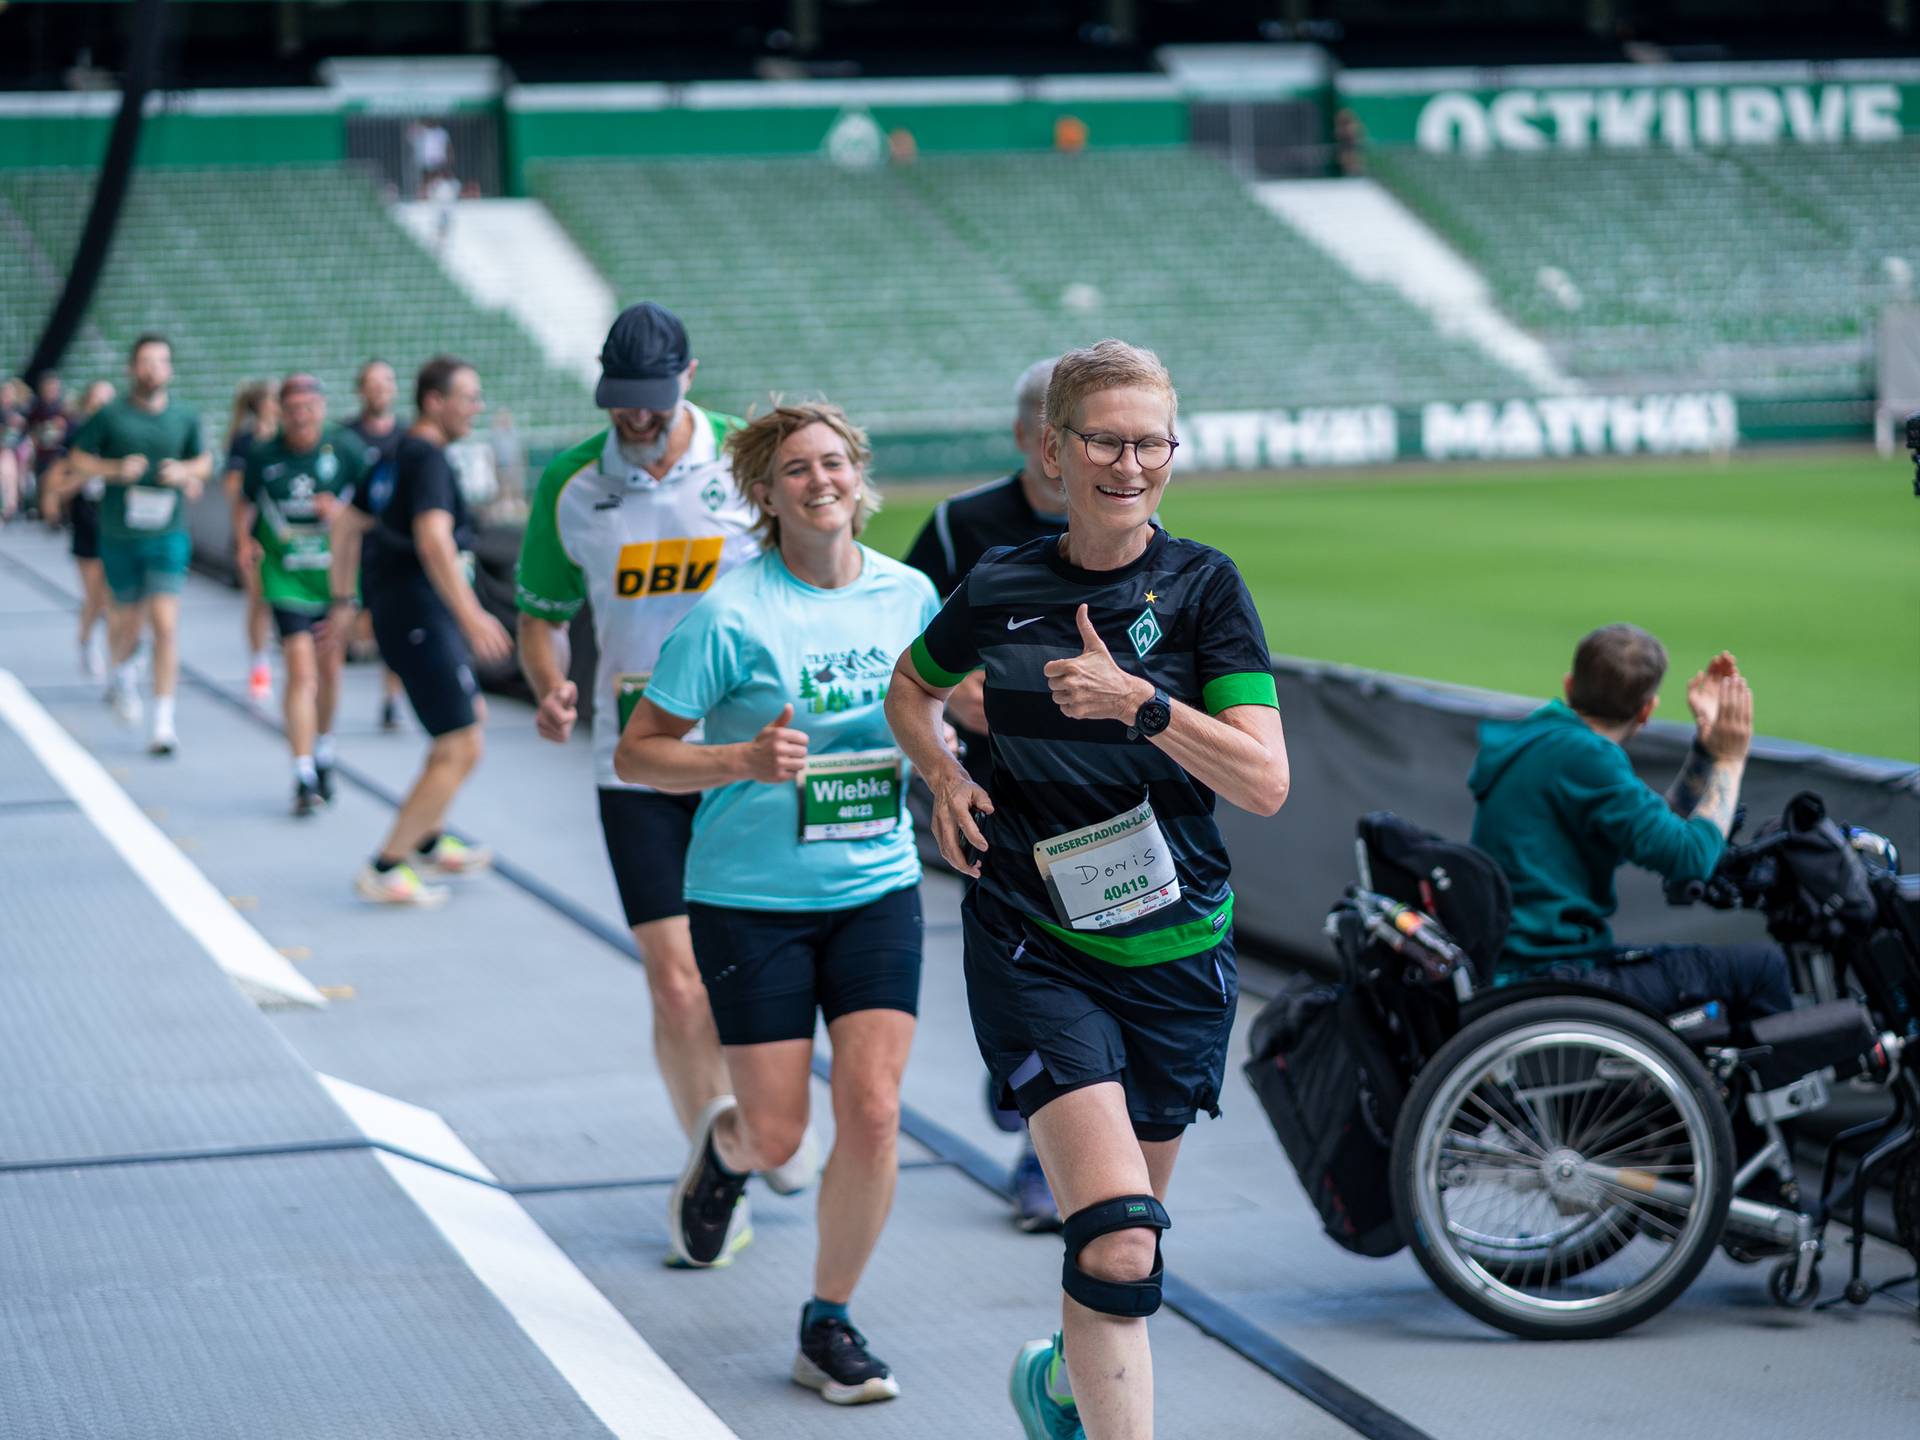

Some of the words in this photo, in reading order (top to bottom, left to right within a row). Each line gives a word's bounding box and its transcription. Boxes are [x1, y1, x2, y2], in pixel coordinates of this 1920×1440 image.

[617, 561, 717, 596] DBV
[812, 777, 892, 802] Wiebke
[1074, 848, 1156, 885] Doris
[1103, 875, 1149, 901] 40419
